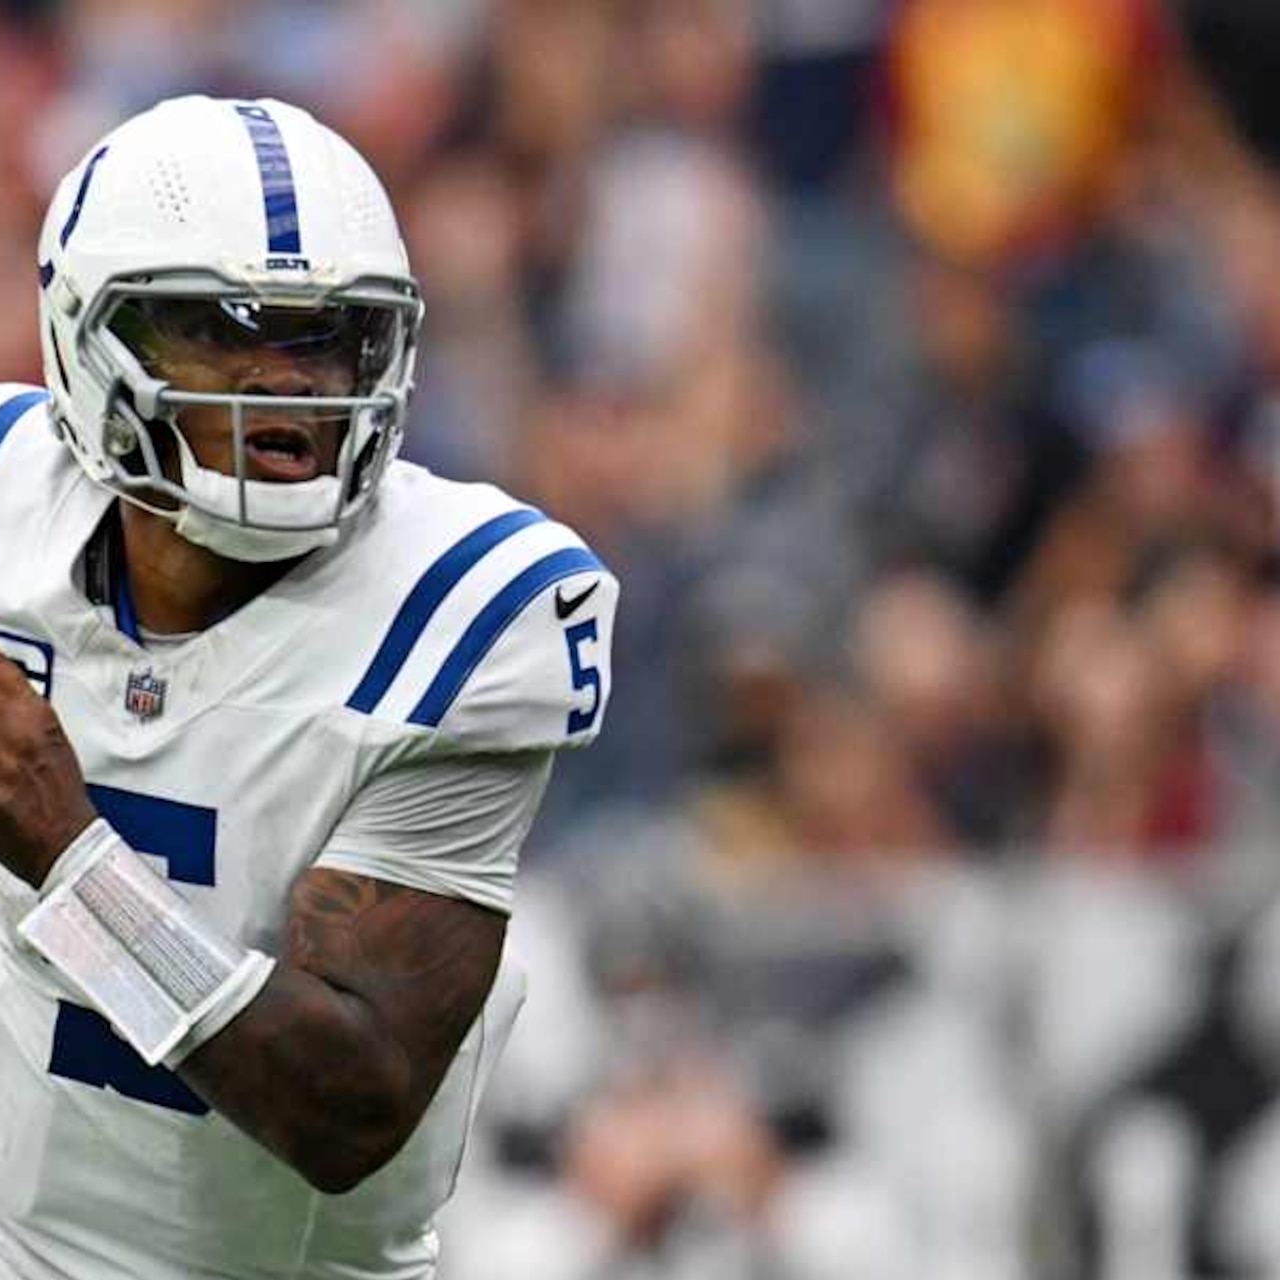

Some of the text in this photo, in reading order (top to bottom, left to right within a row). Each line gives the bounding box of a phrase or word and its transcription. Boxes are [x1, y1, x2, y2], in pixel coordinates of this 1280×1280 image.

[265, 258, 310, 271] COLTS
[565, 617, 601, 734] 5
[128, 689, 158, 715] NFL
